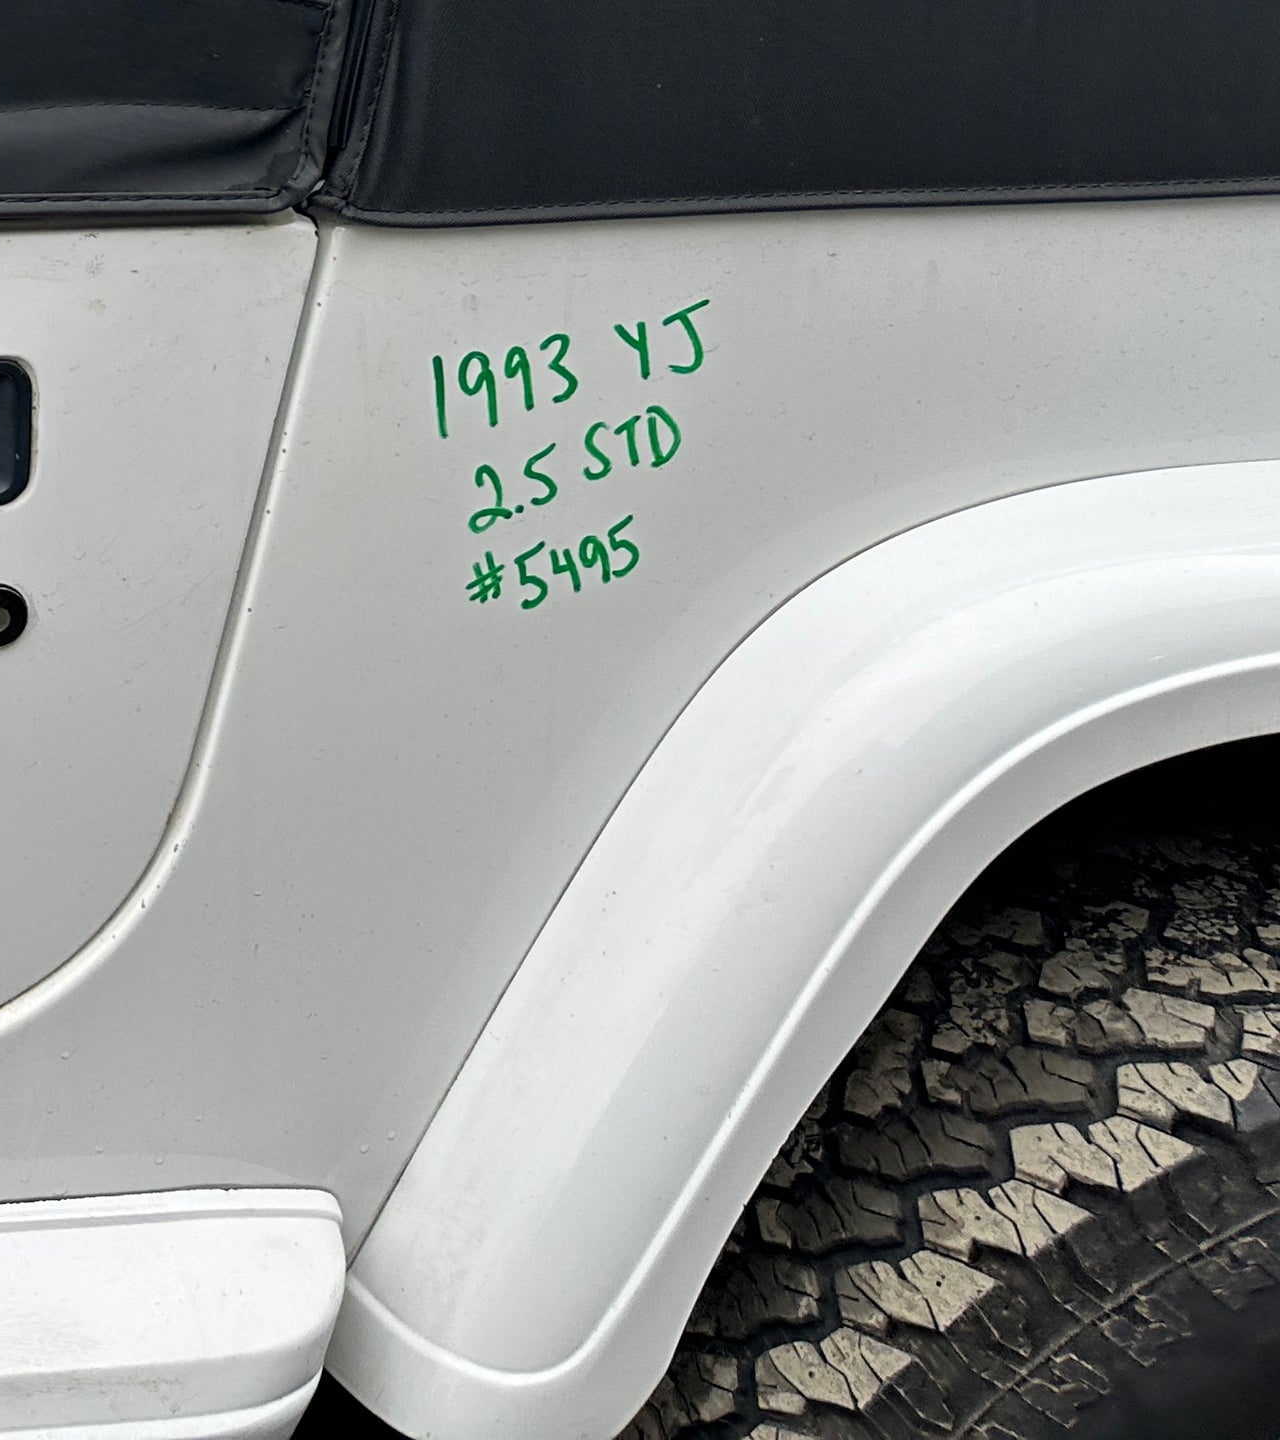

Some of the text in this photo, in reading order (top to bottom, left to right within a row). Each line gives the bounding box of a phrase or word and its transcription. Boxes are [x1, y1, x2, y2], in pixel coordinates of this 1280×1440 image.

[432, 298, 710, 439] 1993 YJ
[468, 405, 682, 534] 2.5 STD
[465, 514, 641, 609] #5495
